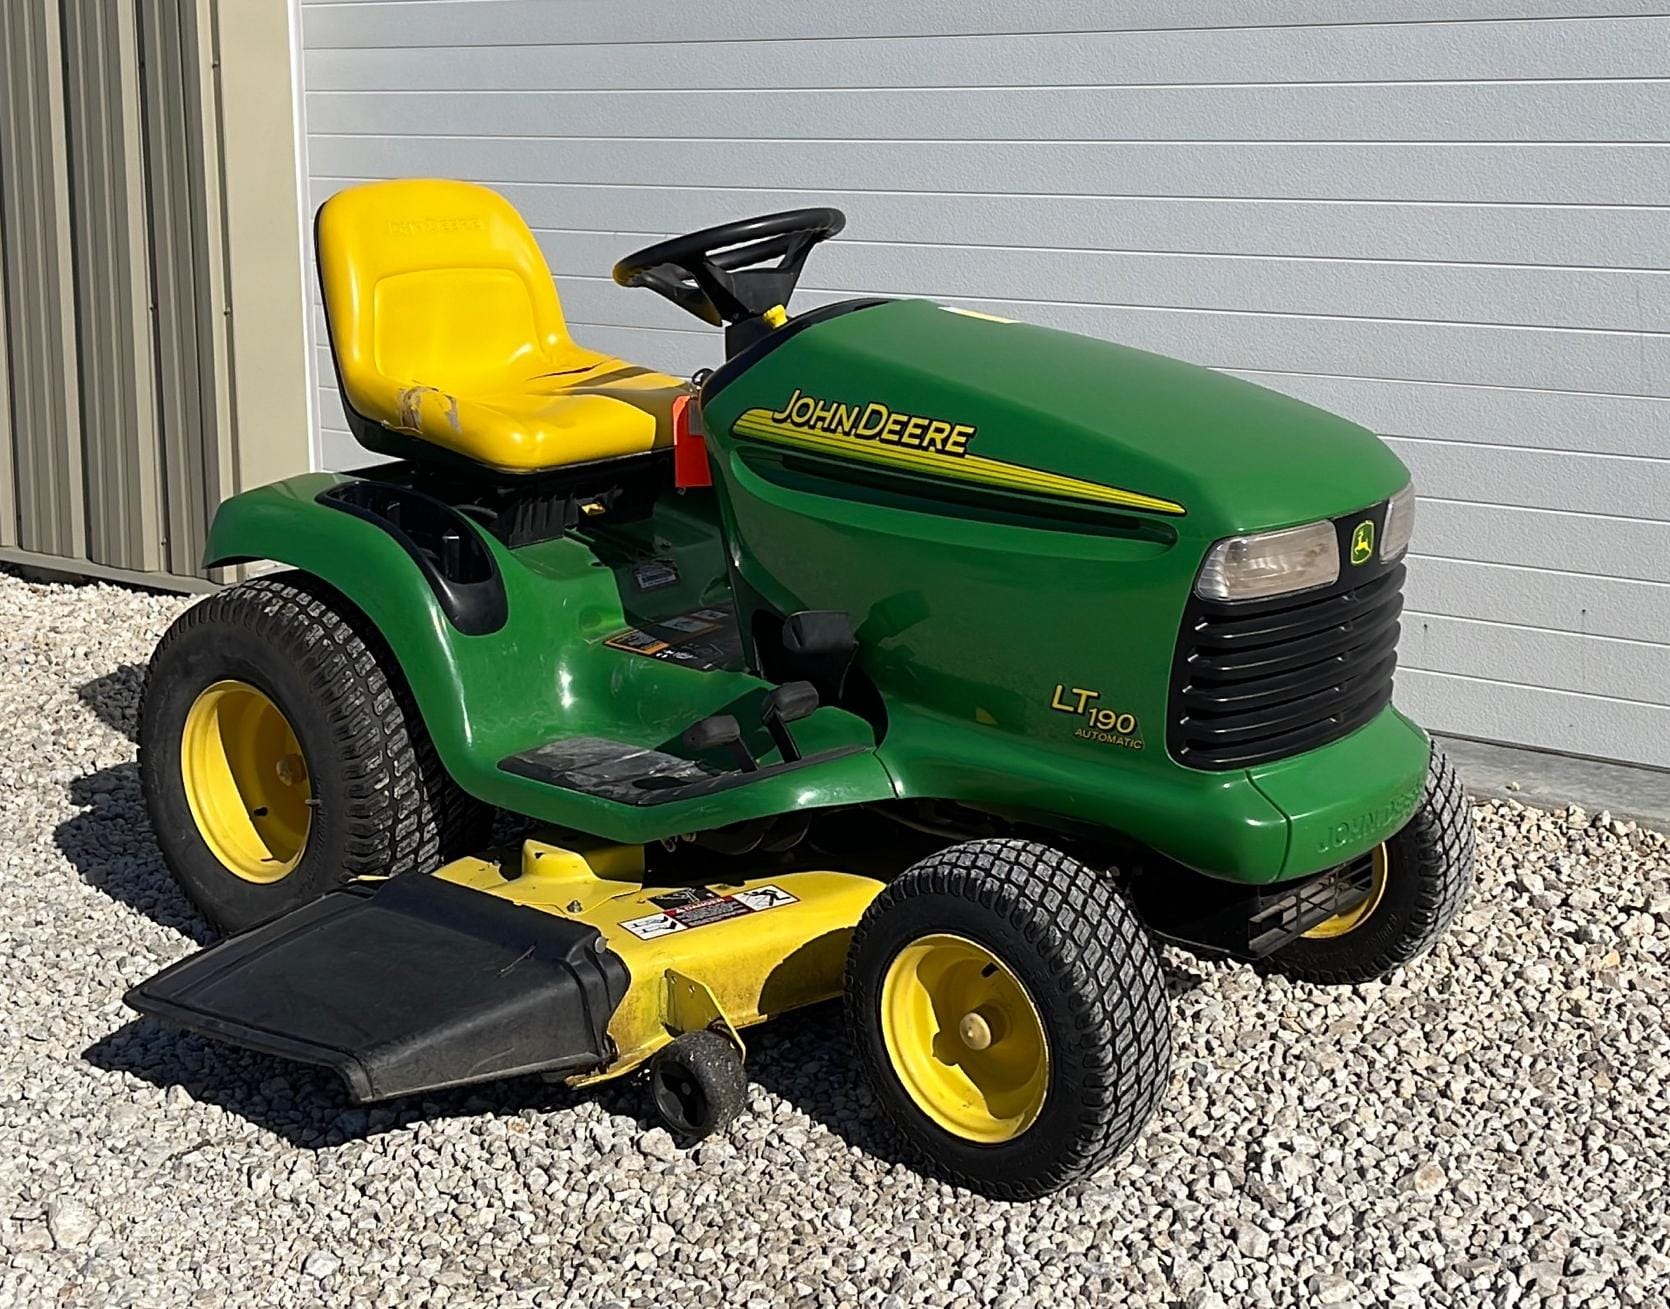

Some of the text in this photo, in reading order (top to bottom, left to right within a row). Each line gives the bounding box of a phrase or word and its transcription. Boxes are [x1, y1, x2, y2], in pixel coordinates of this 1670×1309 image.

[772, 389, 975, 455] JOHN DEERE
[1051, 684, 1136, 734] LT 190
[1074, 728, 1143, 750] AUTOMATIC
